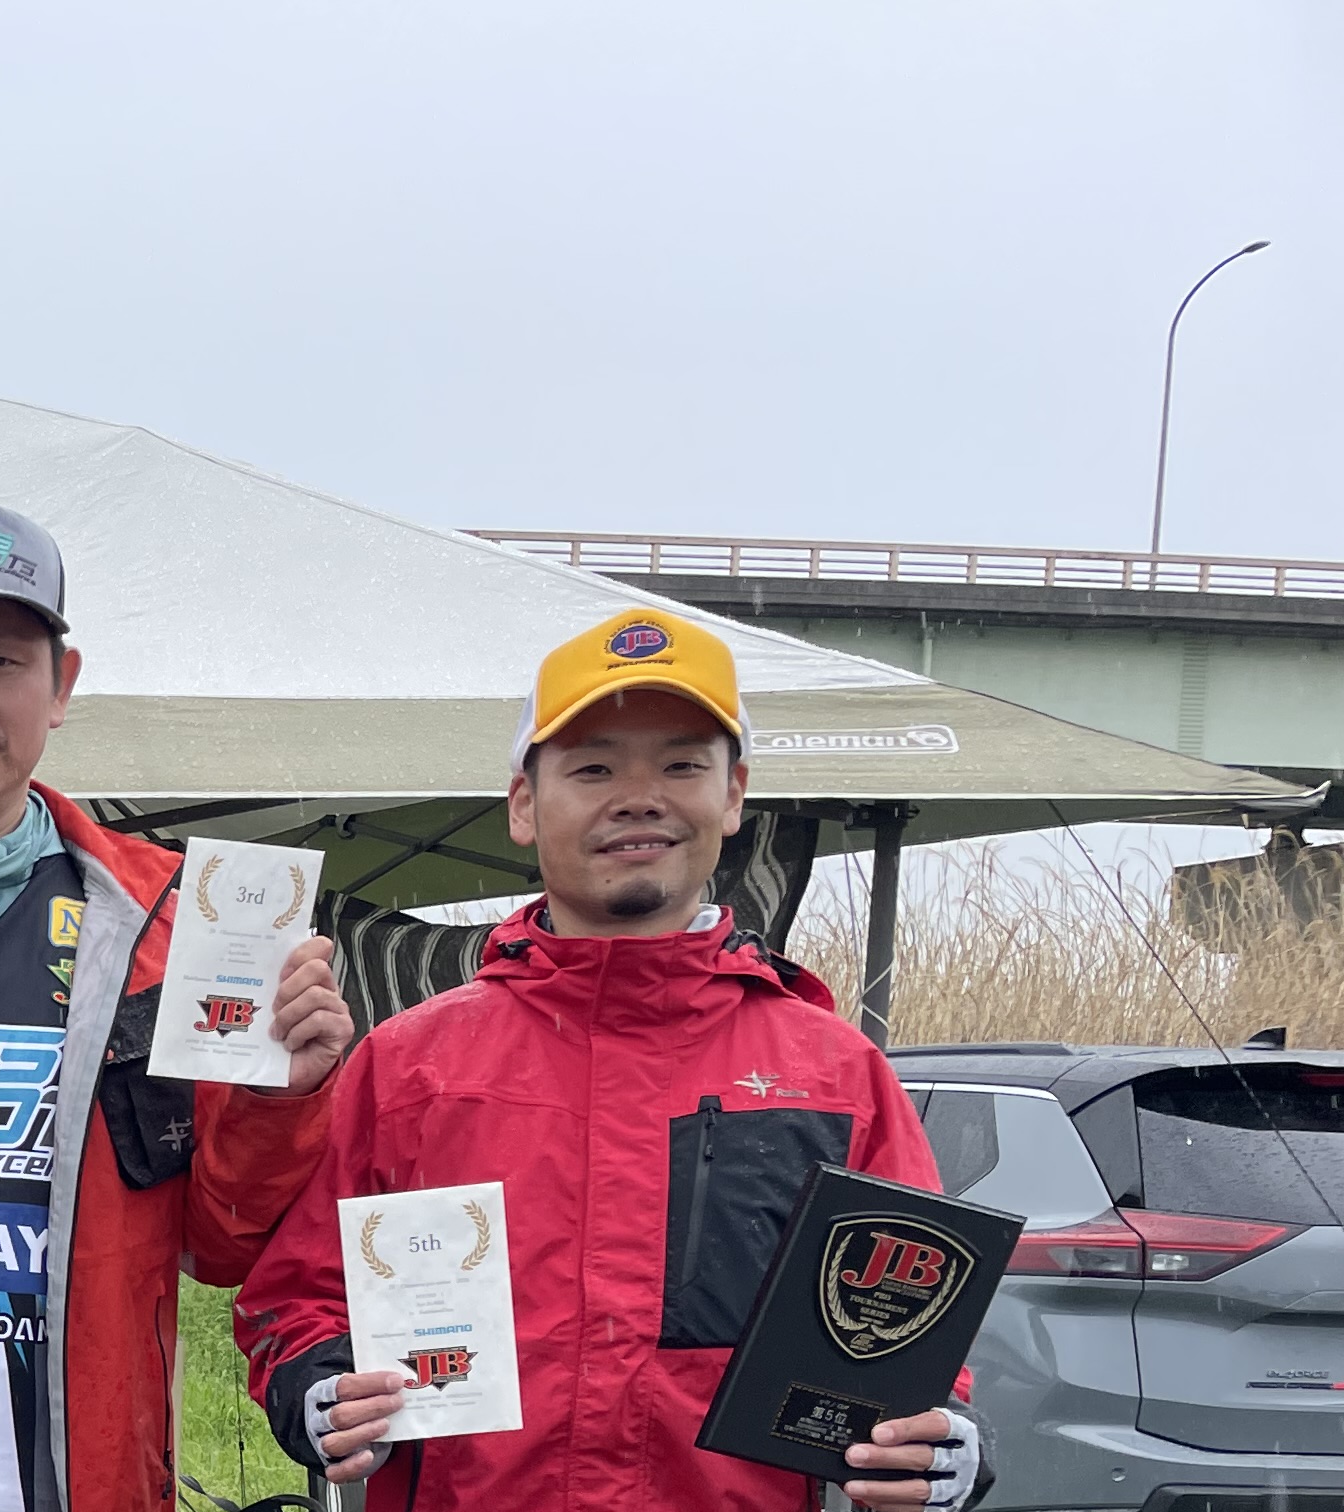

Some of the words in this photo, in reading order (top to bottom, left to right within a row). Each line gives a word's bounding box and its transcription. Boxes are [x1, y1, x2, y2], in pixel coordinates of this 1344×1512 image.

[617, 630, 662, 654] JB
[236, 886, 265, 905] 3rd
[215, 974, 264, 987] SHIMANO
[194, 999, 254, 1033] JB
[408, 1233, 442, 1253] 5th
[840, 1231, 946, 1289] JB
[413, 1324, 473, 1337] SHIMANO
[404, 1350, 472, 1390] JB
